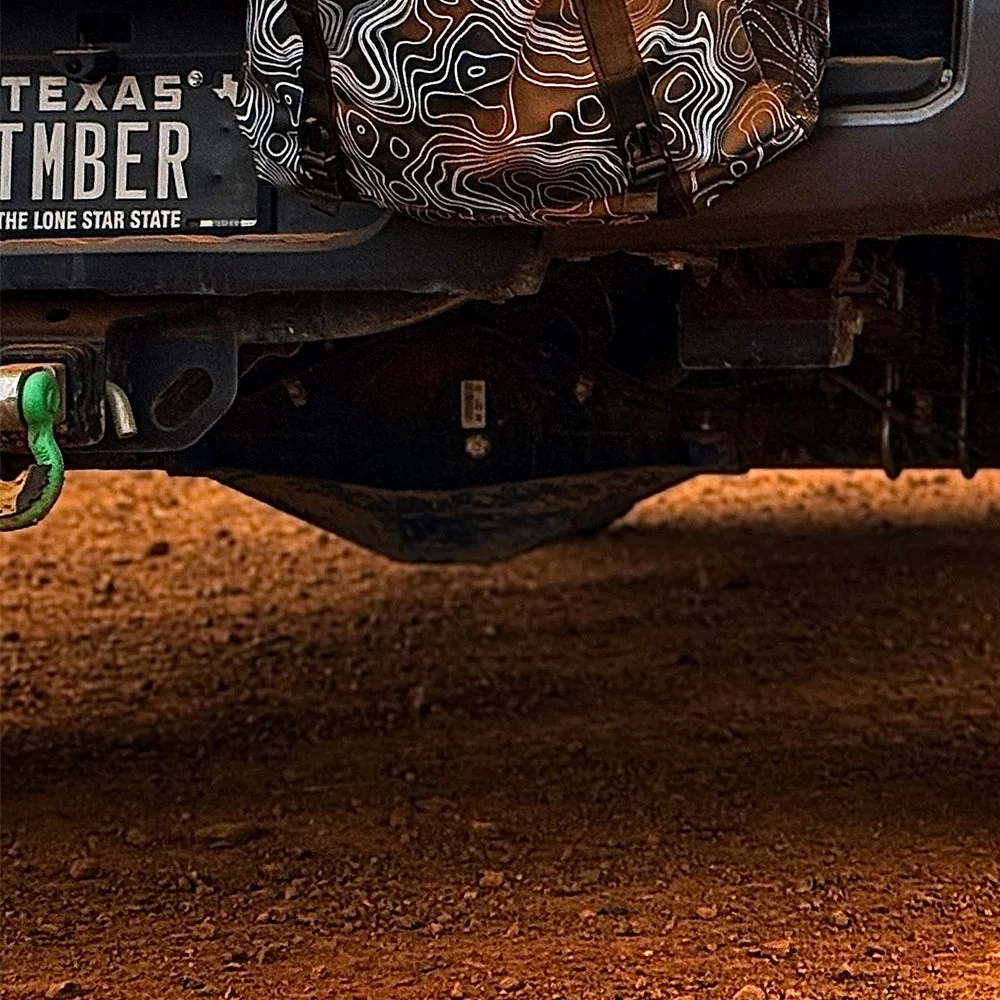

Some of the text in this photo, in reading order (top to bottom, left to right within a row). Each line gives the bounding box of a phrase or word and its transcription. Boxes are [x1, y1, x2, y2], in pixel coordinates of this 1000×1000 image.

[1, 75, 183, 112] TEXAS
[0, 121, 190, 201] TMBER
[33, 211, 77, 230] LONE
[81, 210, 125, 230] STAR
[130, 209, 182, 229] STATE
